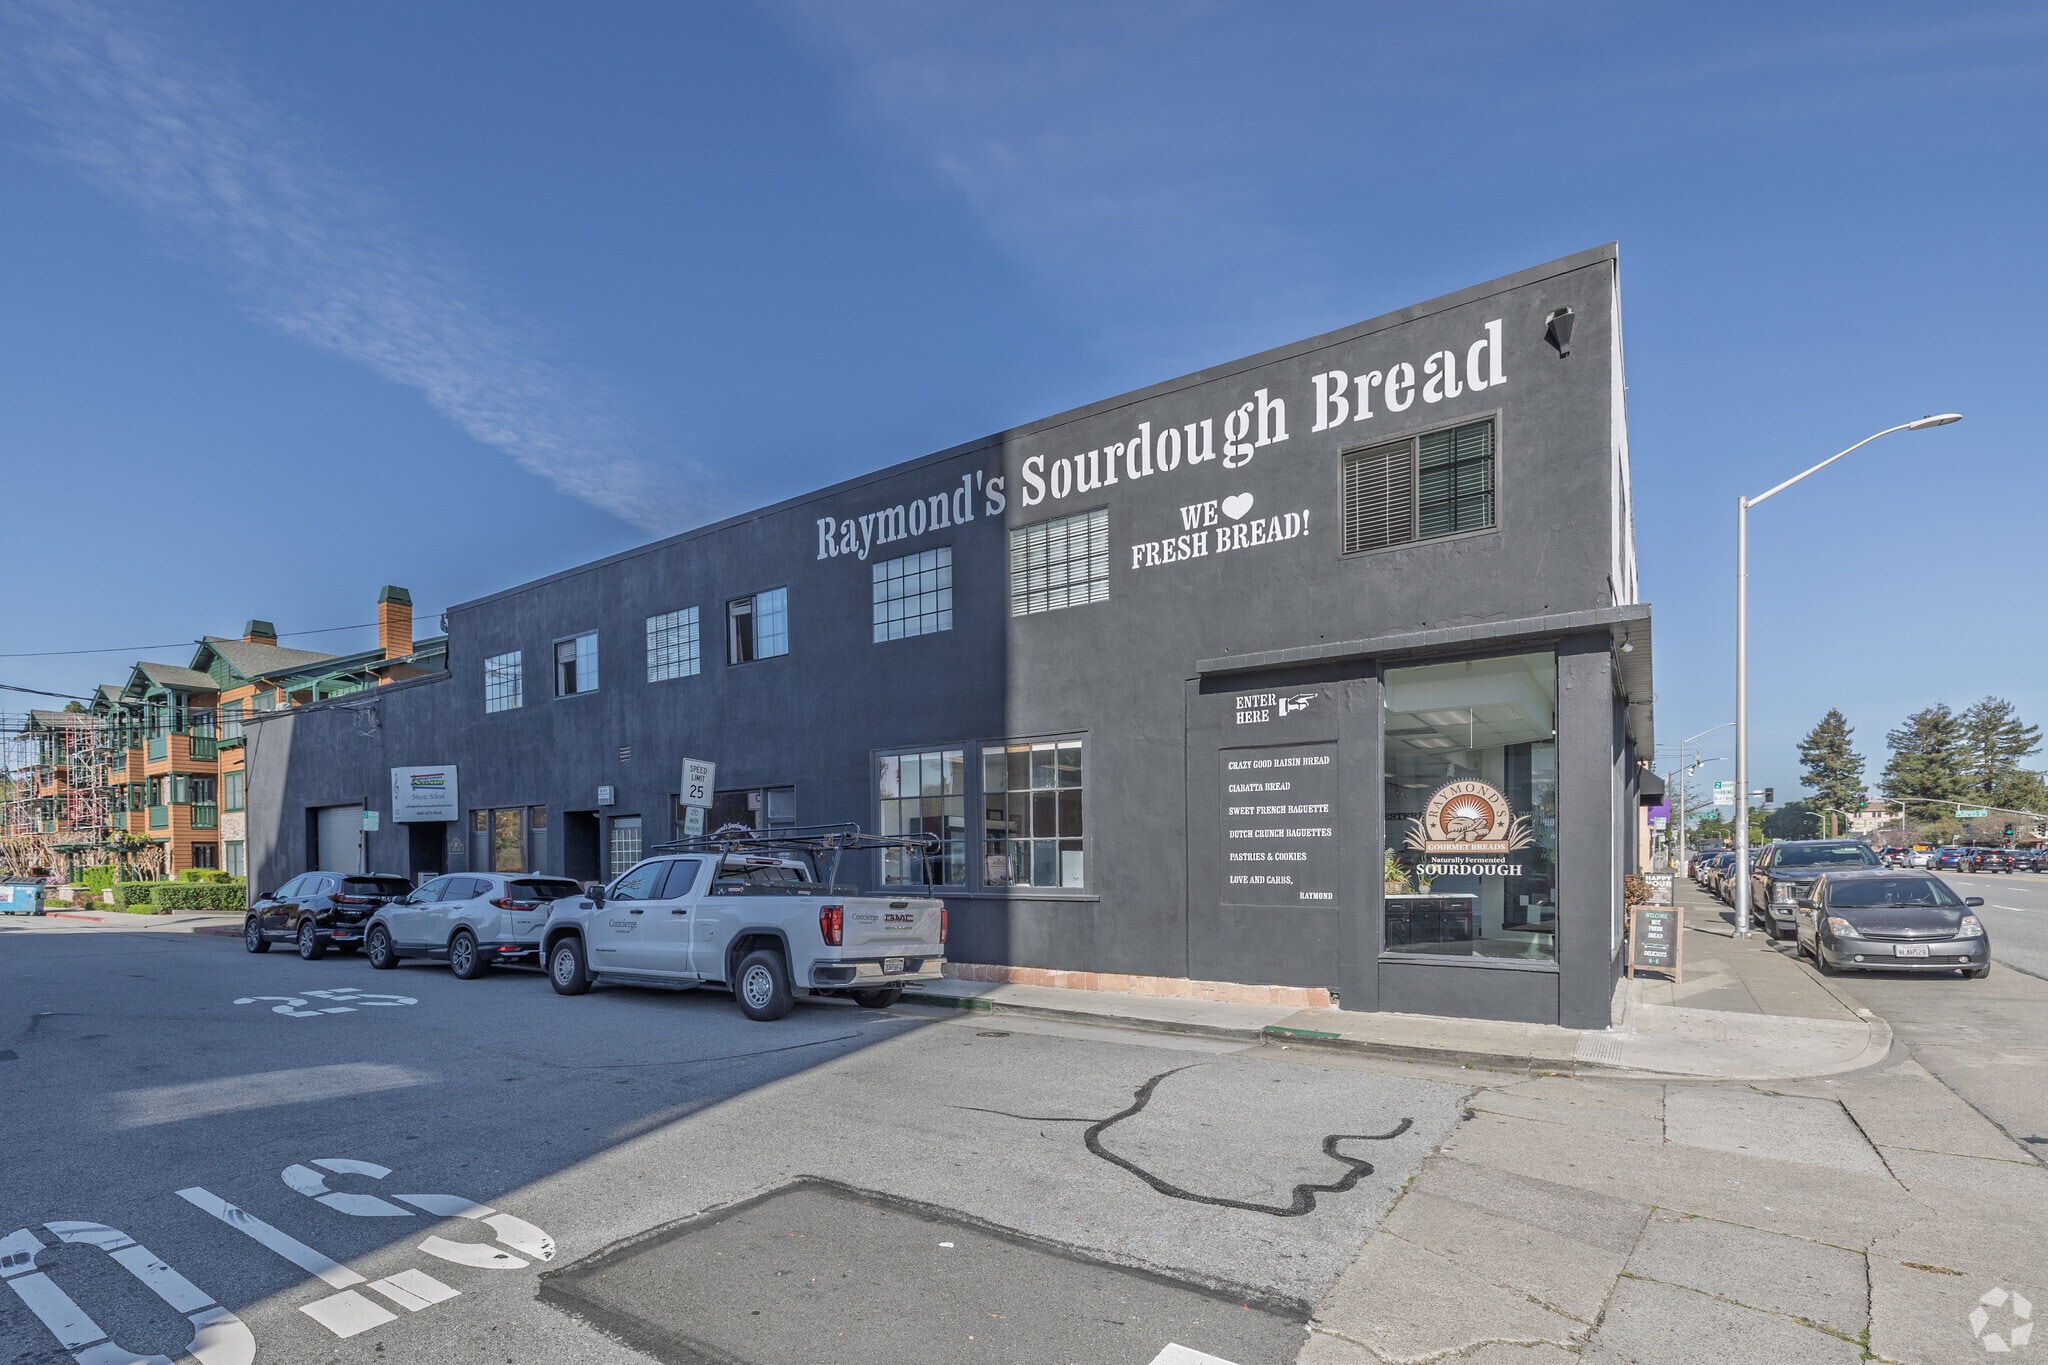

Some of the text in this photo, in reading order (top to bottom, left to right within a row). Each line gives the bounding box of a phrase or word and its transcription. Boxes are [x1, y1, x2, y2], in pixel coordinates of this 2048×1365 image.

[816, 319, 1508, 561] Raymond's Sourdough Bread
[1180, 503, 1219, 531] WE
[1131, 509, 1310, 570] FRESH BREAD!
[1236, 693, 1277, 709] ENTER
[1236, 709, 1270, 725] HERE
[1228, 756, 1330, 770] CRAZY GOOD RAISIN BREAD
[689, 764, 708, 775] SPEED
[691, 774, 706, 783] LIMIT
[689, 784, 704, 799] 25
[1228, 782, 1291, 792] CIABATTA BREAD
[1429, 783, 1507, 818] RAYMOND'S
[1228, 804, 1329, 815] SWEET FRENCH BAGUETTE
[689, 817, 699, 825] MIN
[1229, 828, 1332, 838] DUTCH CRUNCH BAGUETTES
[1428, 843, 1506, 851] GOURMET BREADS
[1229, 852, 1307, 861] PASTRIES & COOKIES
[1431, 856, 1464, 865] Naturally
[1416, 864, 1523, 876] SOURDOUGH
[1230, 875, 1293, 885] LOVE AND CARBS,
[1299, 892, 1333, 900] RAYMOND
[851, 913, 879, 922] Concierge
[884, 914, 914, 922] GMC
[609, 918, 638, 931] Concierge
